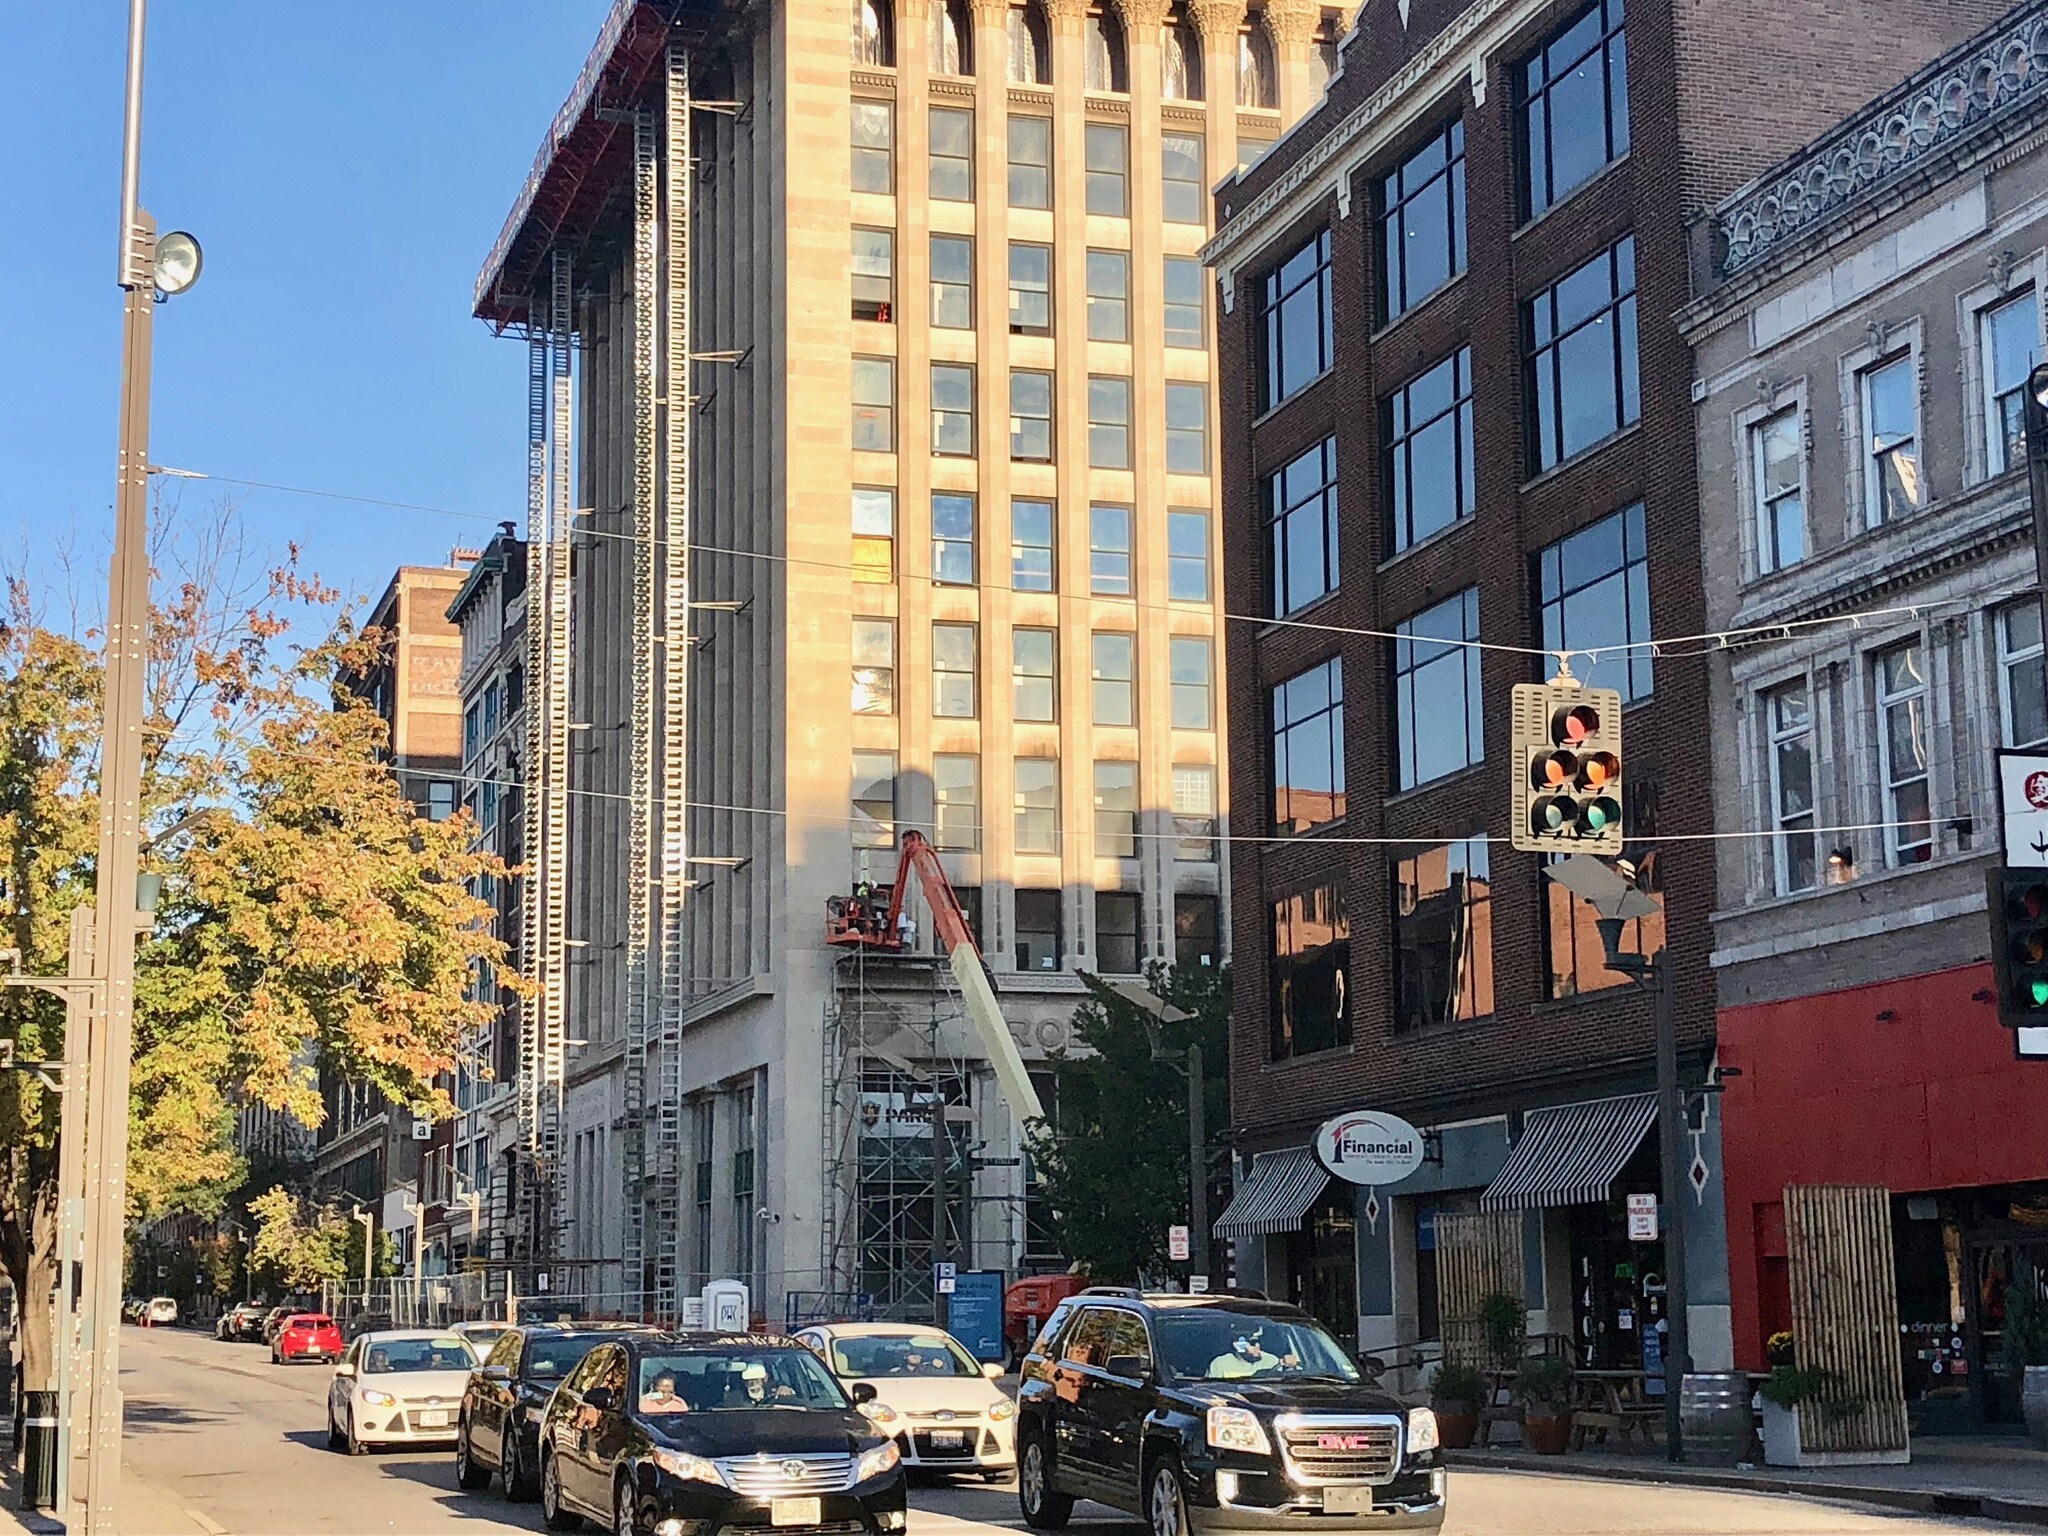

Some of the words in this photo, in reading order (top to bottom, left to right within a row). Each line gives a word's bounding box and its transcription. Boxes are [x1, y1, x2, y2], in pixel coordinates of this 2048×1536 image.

[1343, 1140, 1413, 1154] Financial
[1636, 1198, 1648, 1206] NO
[1317, 1434, 1370, 1450] GMC
